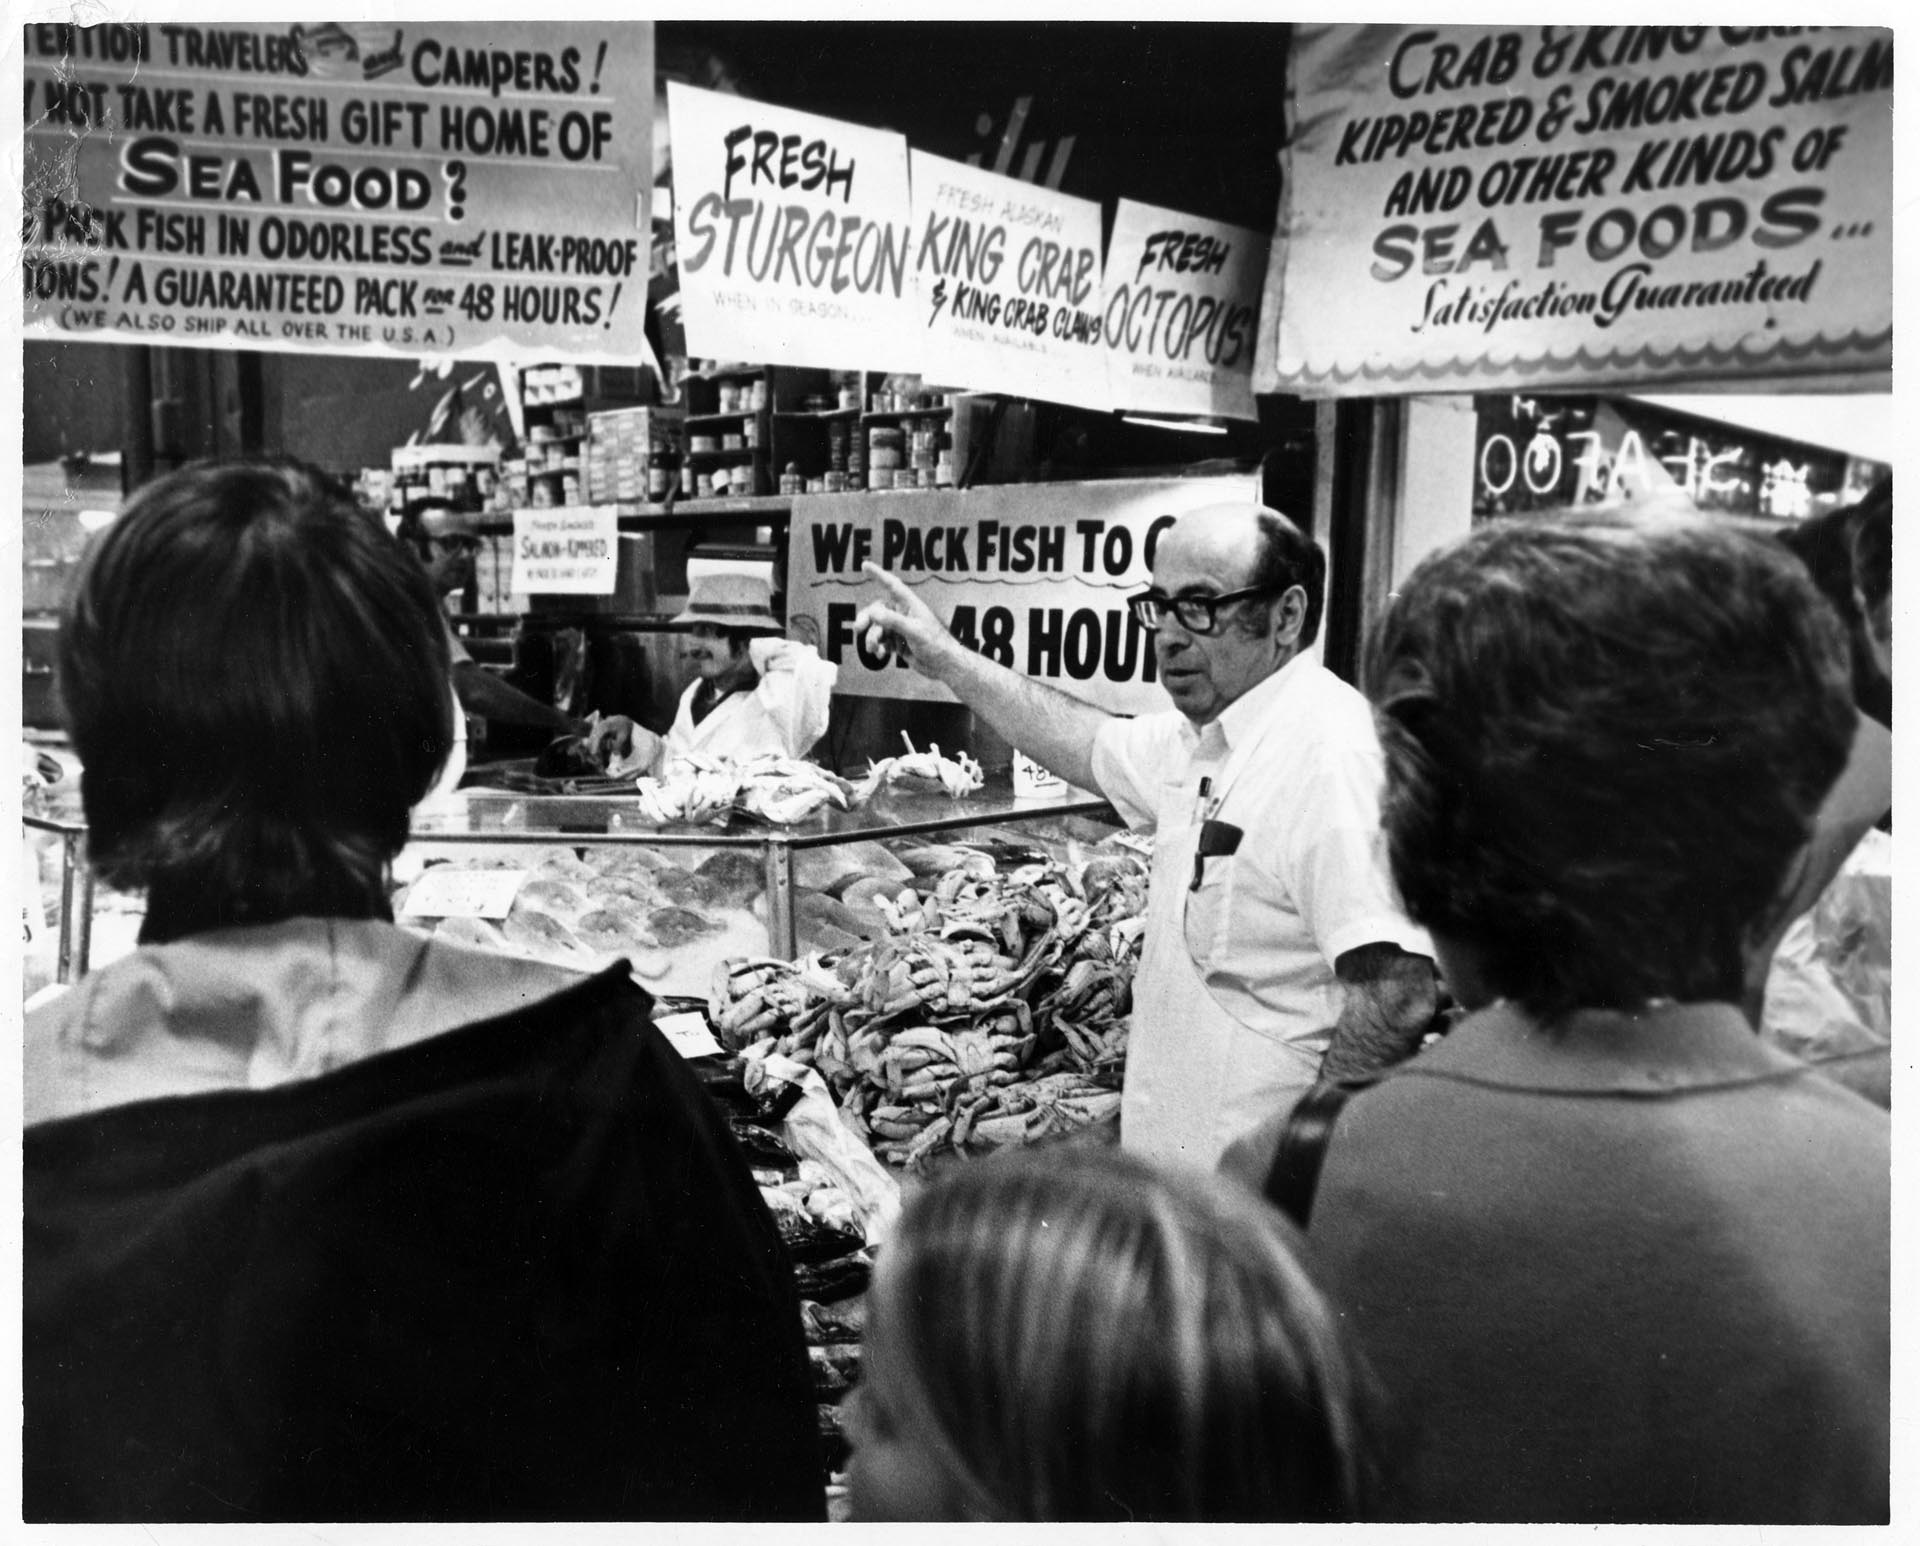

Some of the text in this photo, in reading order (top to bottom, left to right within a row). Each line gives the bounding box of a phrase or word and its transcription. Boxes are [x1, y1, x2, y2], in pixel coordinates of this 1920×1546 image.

[160, 24, 308, 77] TRAVELERS
[1388, 29, 1523, 99] CRAB
[44, 81, 109, 128] NOT
[117, 84, 195, 134] TAKE
[203, 90, 225, 136] A
[233, 92, 328, 142] FRESH
[340, 98, 430, 149] GIFT
[440, 104, 550, 158] HOME
[558, 110, 613, 162] OF
[1334, 96, 1534, 167] KIPPERED
[1535, 84, 1576, 143] &
[1572, 60, 1767, 135] SMOKED
[118, 136, 263, 198] SEA
[724, 124, 856, 204] FRESH
[1383, 124, 1849, 219] AND OTHER KINDS OF
[136, 207, 205, 256] FISH
[217, 213, 249, 256] IN
[258, 215, 432, 266] ODORLESS
[438, 230, 486, 266] and
[490, 231, 638, 277] LEAK-PROOF
[683, 191, 911, 300] STURGEON
[916, 210, 1095, 307] KING CRAB
[1134, 230, 1231, 285] FRESH
[1369, 216, 1510, 283] SEA
[60, 308, 107, 331] (WE
[115, 312, 176, 332] ALSO
[233, 318, 272, 337] ALL
[281, 321, 328, 340] OVER
[336, 324, 371, 342] THE
[122, 262, 148, 304] A
[154, 267, 345, 314] GUARANTEED
[354, 277, 419, 318] PACK
[459, 282, 495, 322] 48
[503, 281, 622, 330] HOURS!
[712, 290, 757, 311] WHEN
[928, 277, 1103, 345] & KING CRAB CLAWS
[1104, 282, 1252, 367] OCTOPUS
[1410, 257, 1823, 334] Satisfaction Guaranteed
[811, 522, 872, 573] WE
[882, 518, 970, 572] PACK
[976, 519, 1066, 573] FISH
[1076, 519, 1133, 577] TO
[950, 605, 1015, 670] 48
